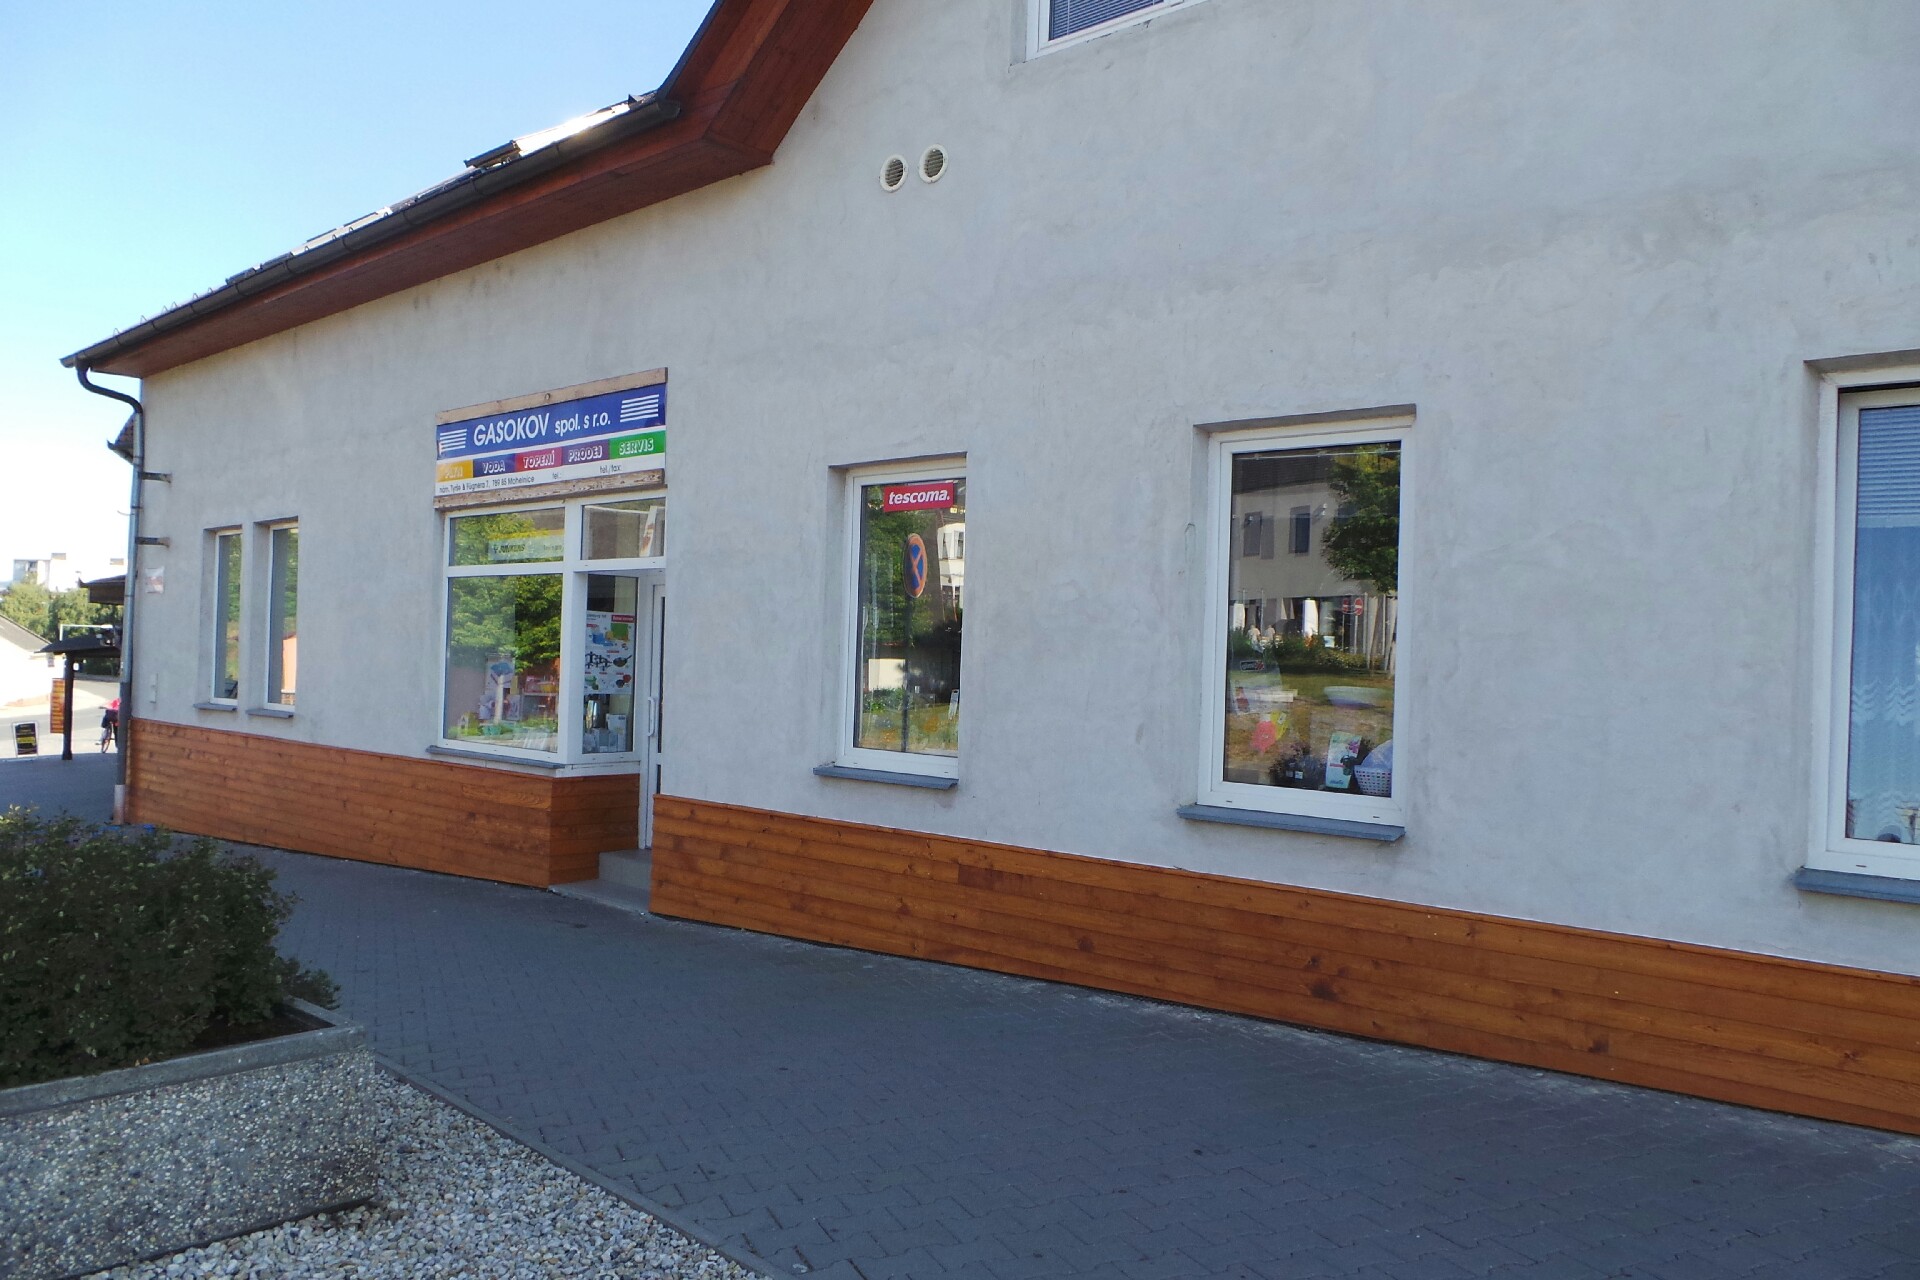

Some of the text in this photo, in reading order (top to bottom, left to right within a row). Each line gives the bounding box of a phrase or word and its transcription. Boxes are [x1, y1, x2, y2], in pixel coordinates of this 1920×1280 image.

[473, 412, 611, 446] GASOKOV spol. s r.o.
[482, 460, 506, 474] VODA
[523, 450, 555, 469] TOPENÍ
[568, 445, 603, 463] PRODEJ
[619, 438, 654, 456] SERVIS
[508, 475, 535, 486] Mohelnice
[888, 489, 950, 505] tescoma.
